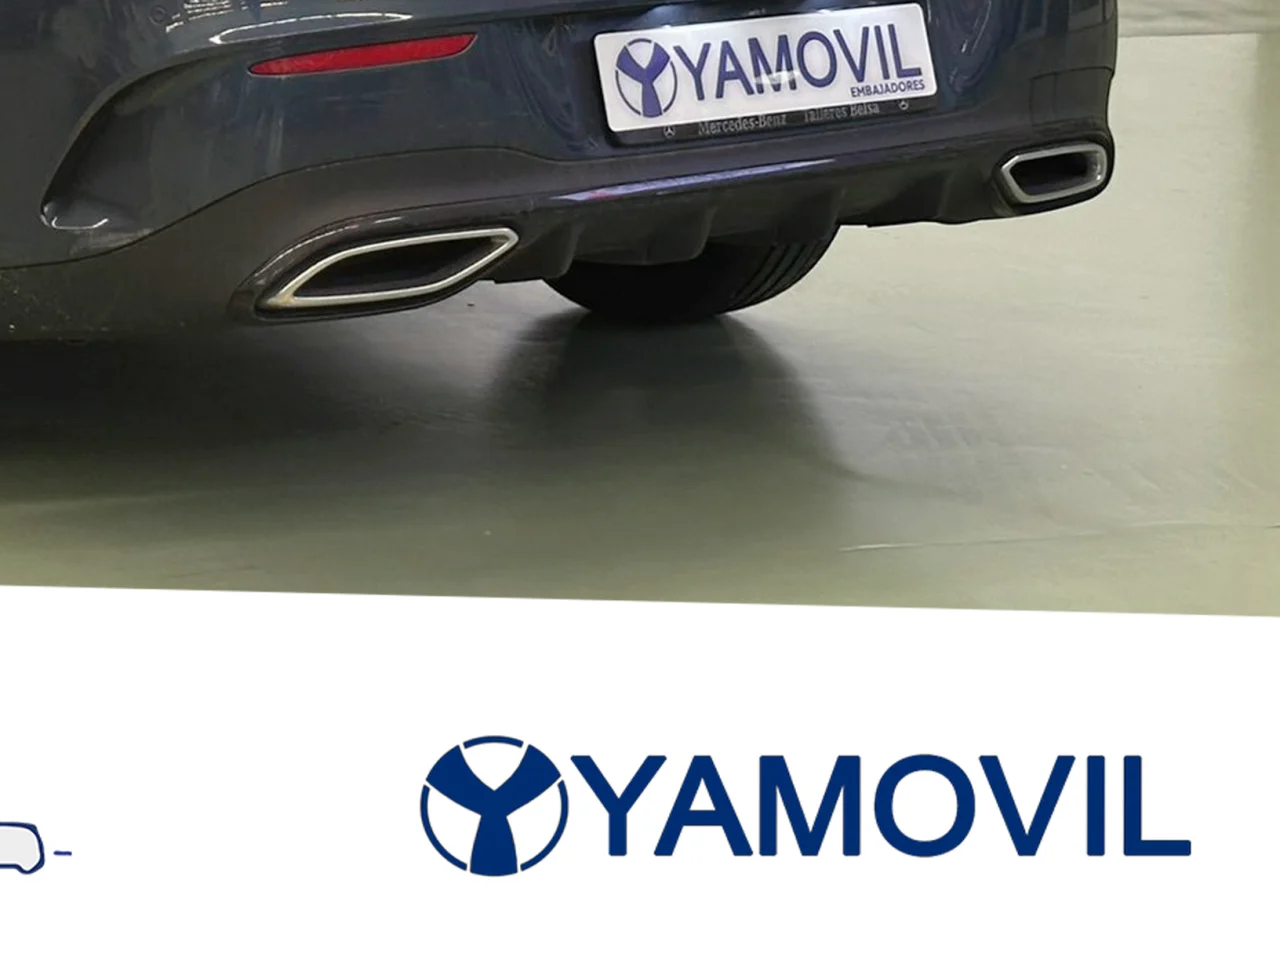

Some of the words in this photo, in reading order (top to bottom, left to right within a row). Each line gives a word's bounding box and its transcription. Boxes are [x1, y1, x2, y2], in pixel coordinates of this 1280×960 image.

[673, 24, 923, 101] YAMOVIL
[850, 78, 925, 98] EMBAJADORES
[698, 115, 787, 136] Mercedes-Benz
